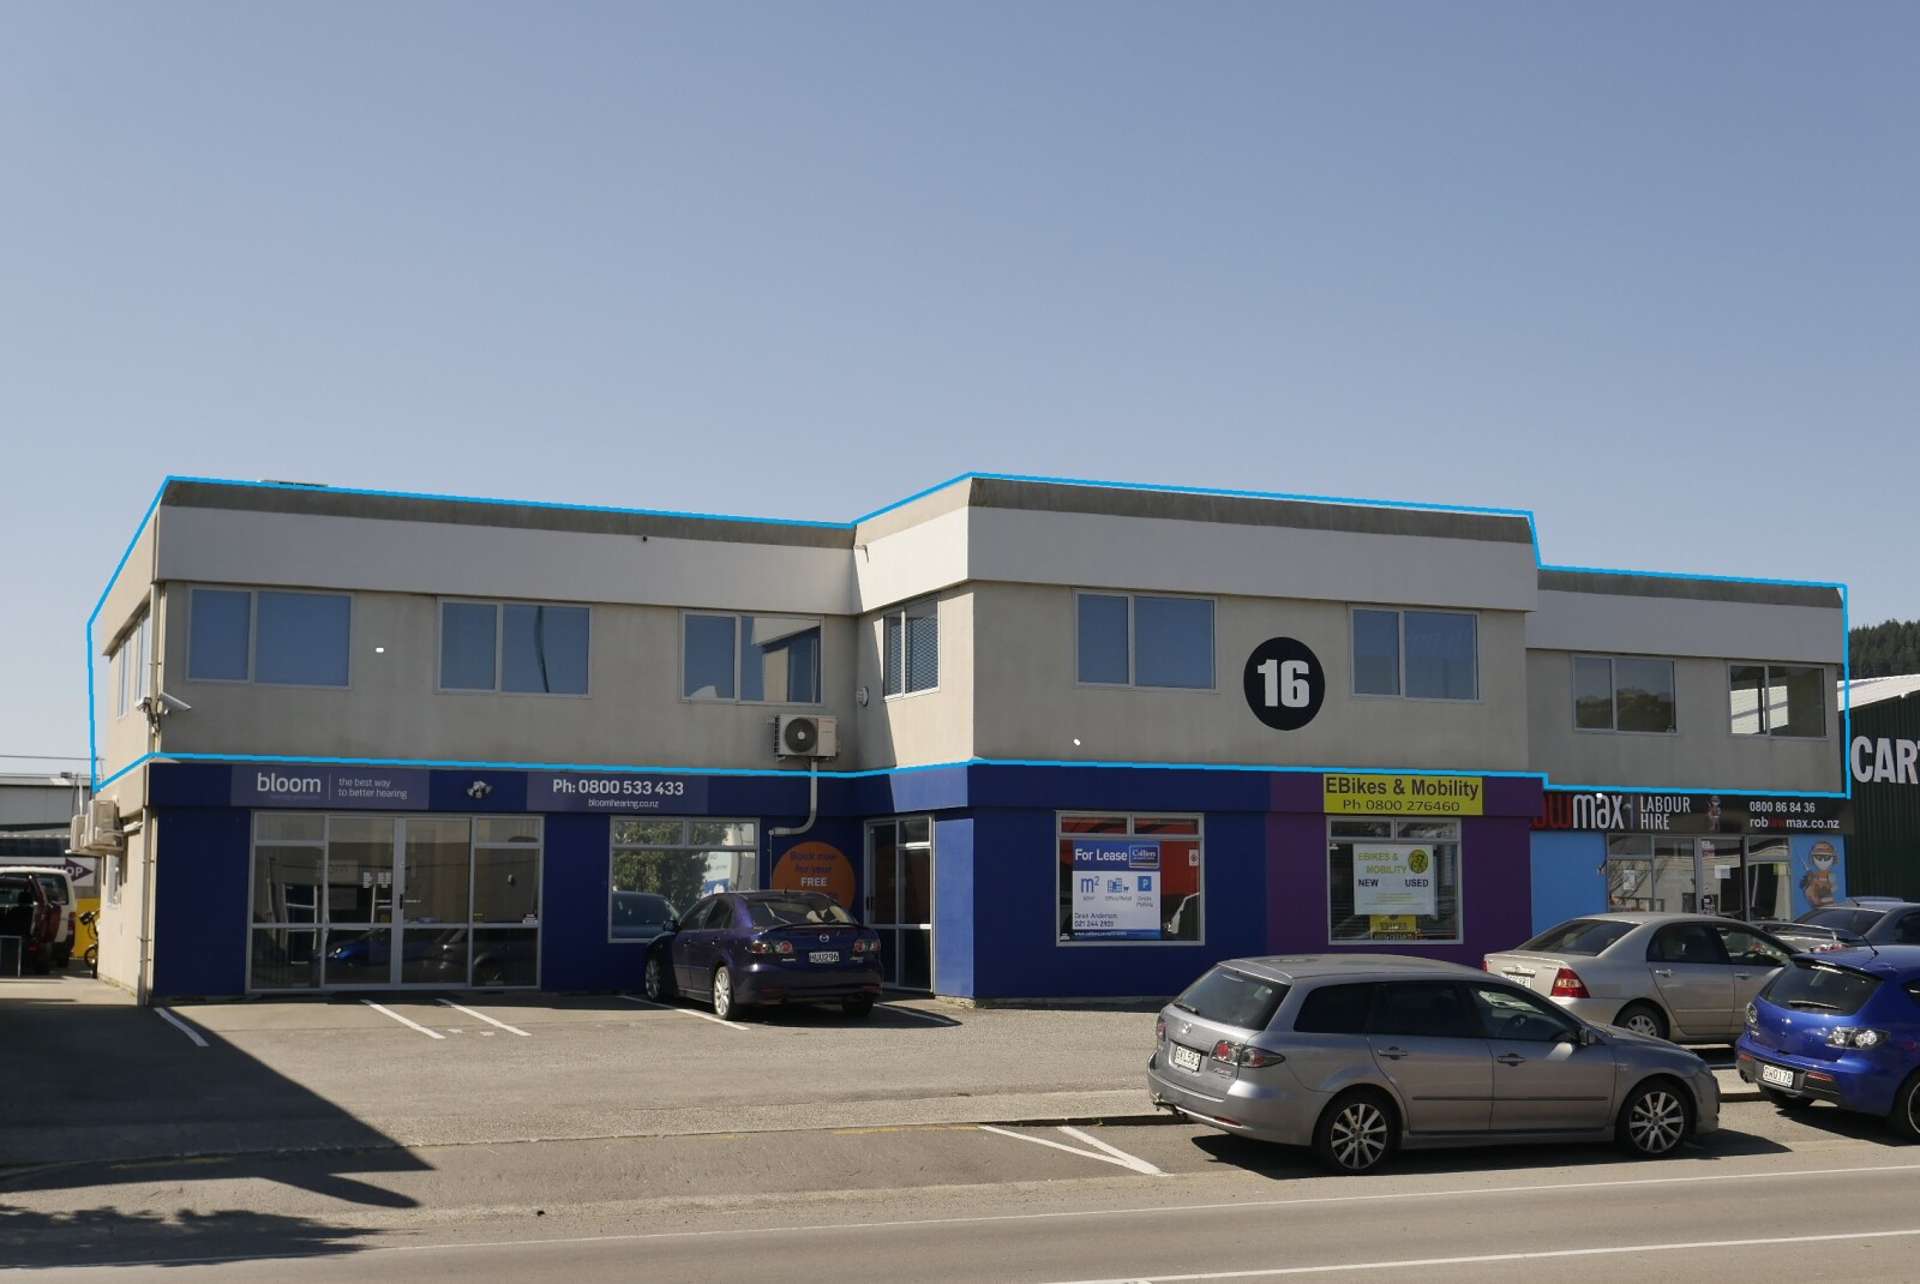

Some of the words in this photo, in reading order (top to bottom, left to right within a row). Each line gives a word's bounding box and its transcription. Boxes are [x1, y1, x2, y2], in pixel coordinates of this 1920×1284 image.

[1257, 658, 1310, 708] 16
[1851, 736, 1920, 784] CAR
[257, 772, 321, 793] bloom
[339, 777, 353, 787] the
[354, 778, 373, 788] best
[374, 779, 391, 789] way
[553, 779, 576, 793] Ph:
[578, 779, 620, 794] 0800
[623, 780, 652, 795] 533
[654, 781, 684, 795] 433
[1326, 777, 1387, 795] EBikes
[1393, 778, 1405, 795] &
[1412, 779, 1479, 801] Mobility
[338, 788, 348, 797] to
[349, 788, 374, 798] better
[376, 789, 408, 800] hearing
[1343, 799, 1361, 810] Ph
[1366, 799, 1402, 811] 0800
[1407, 801, 1460, 812] 276460
[1640, 795, 1691, 813] LABOUR
[1749, 801, 1773, 812] 0800
[1775, 801, 1787, 813] 86
[1789, 802, 1801, 813] 84
[1803, 802, 1816, 813] 36
[1640, 813, 1671, 831] HIRE
[1075, 848, 1094, 861] For
[1096, 849, 1128, 861] Lease
[800, 877, 828, 887] FREE
[1358, 878, 1379, 888] NEW
[1405, 879, 1429, 888] USED
